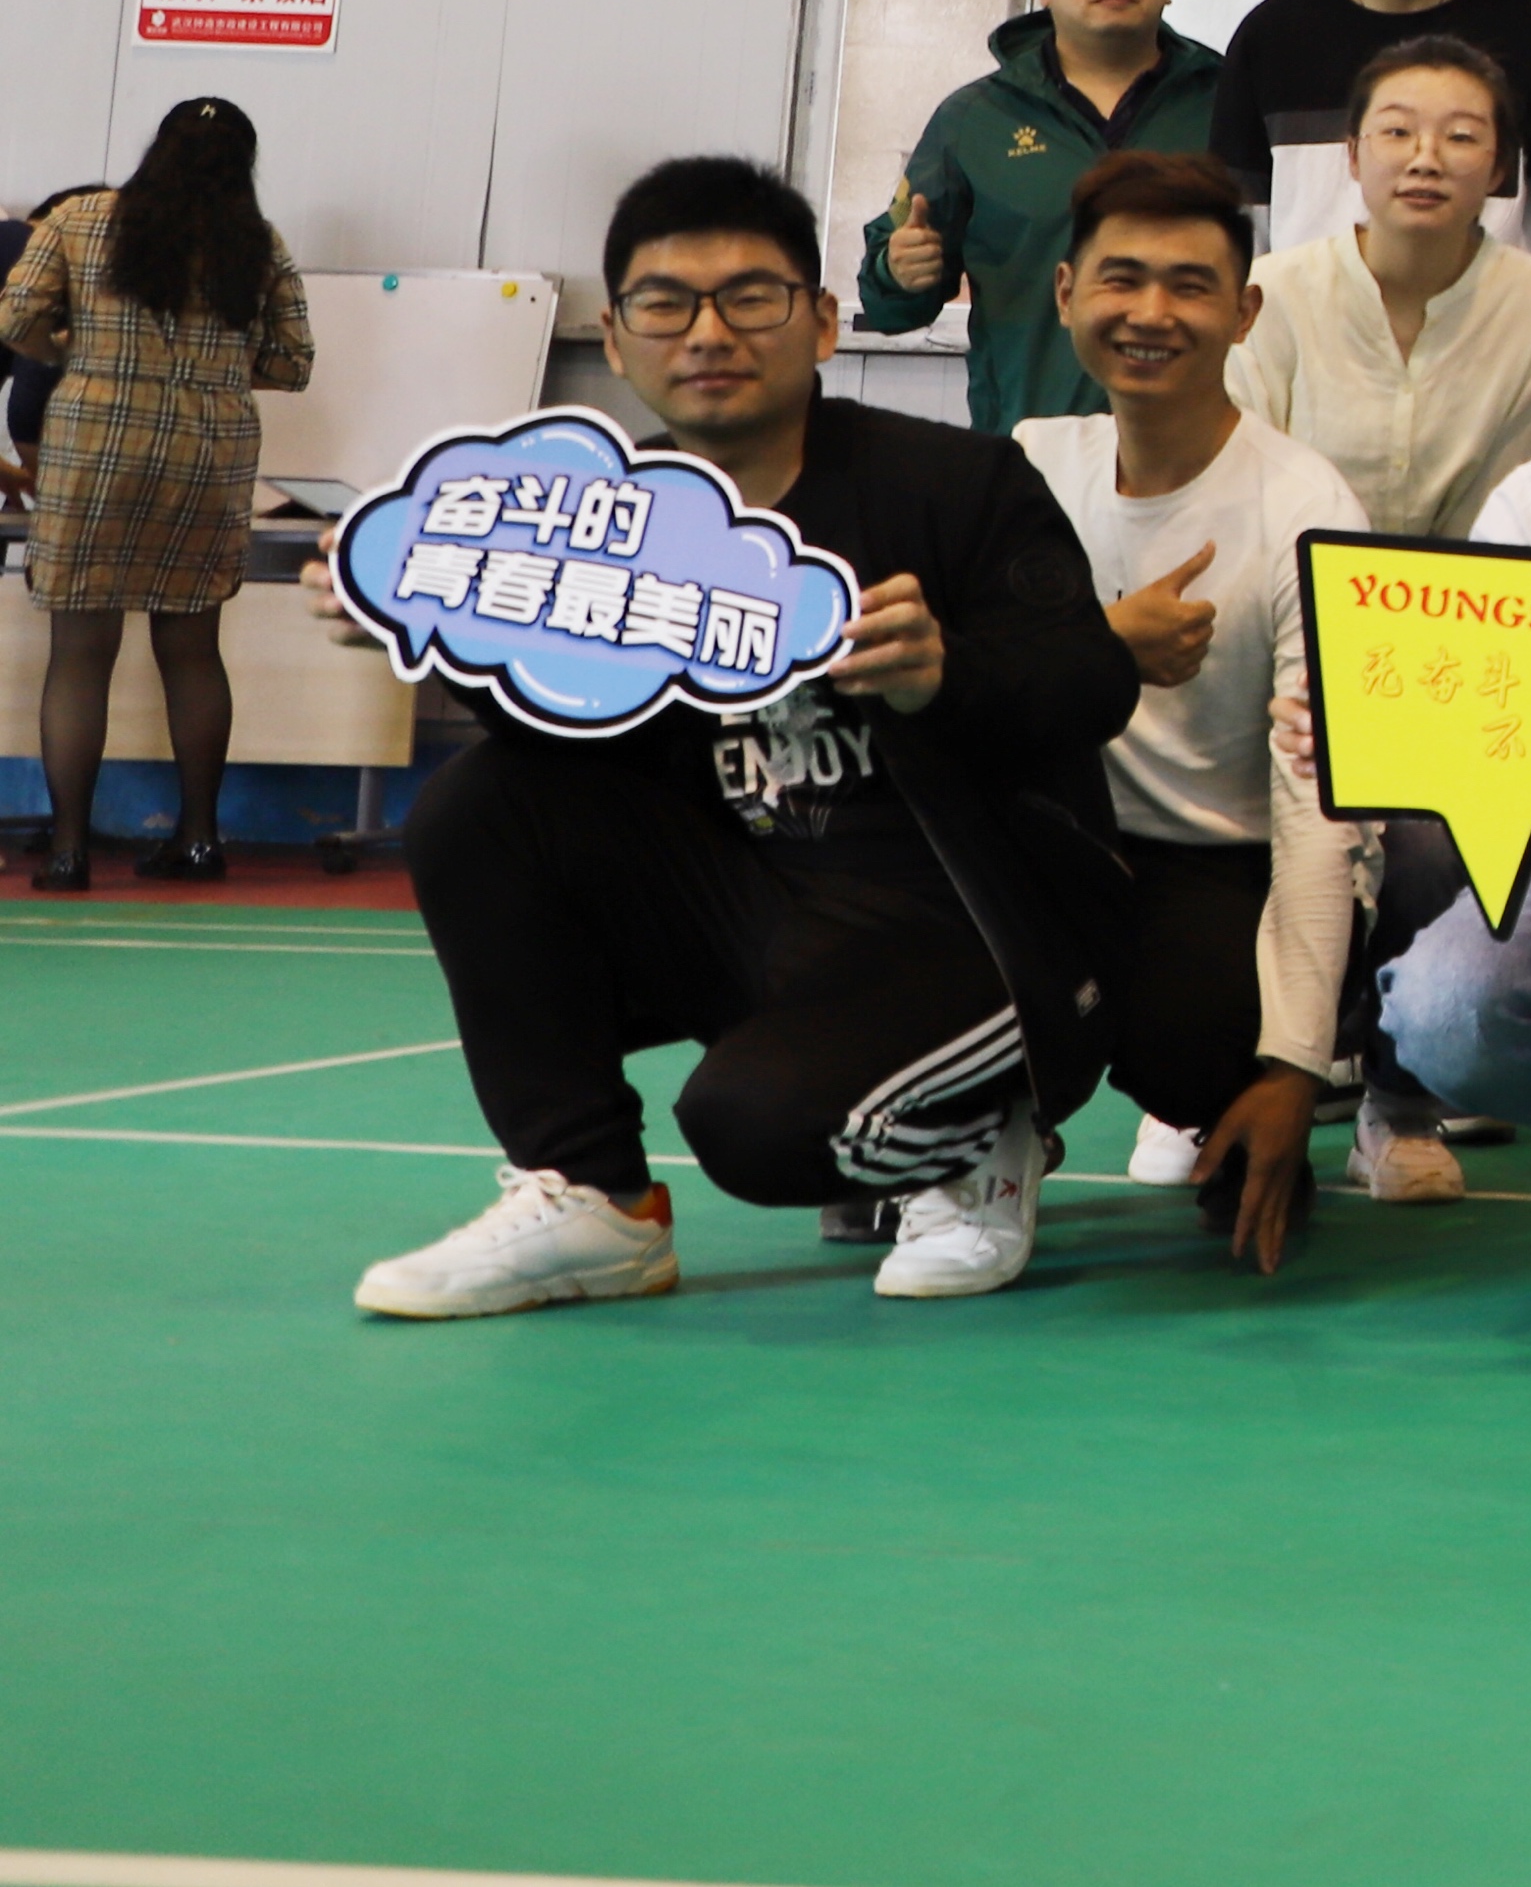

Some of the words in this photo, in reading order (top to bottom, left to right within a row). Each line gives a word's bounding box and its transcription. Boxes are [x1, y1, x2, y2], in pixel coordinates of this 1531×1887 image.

[421, 475, 654, 556] 奋斗的
[396, 543, 781, 675] 青春最美丽
[1362, 644, 1520, 710] 无奋斗
